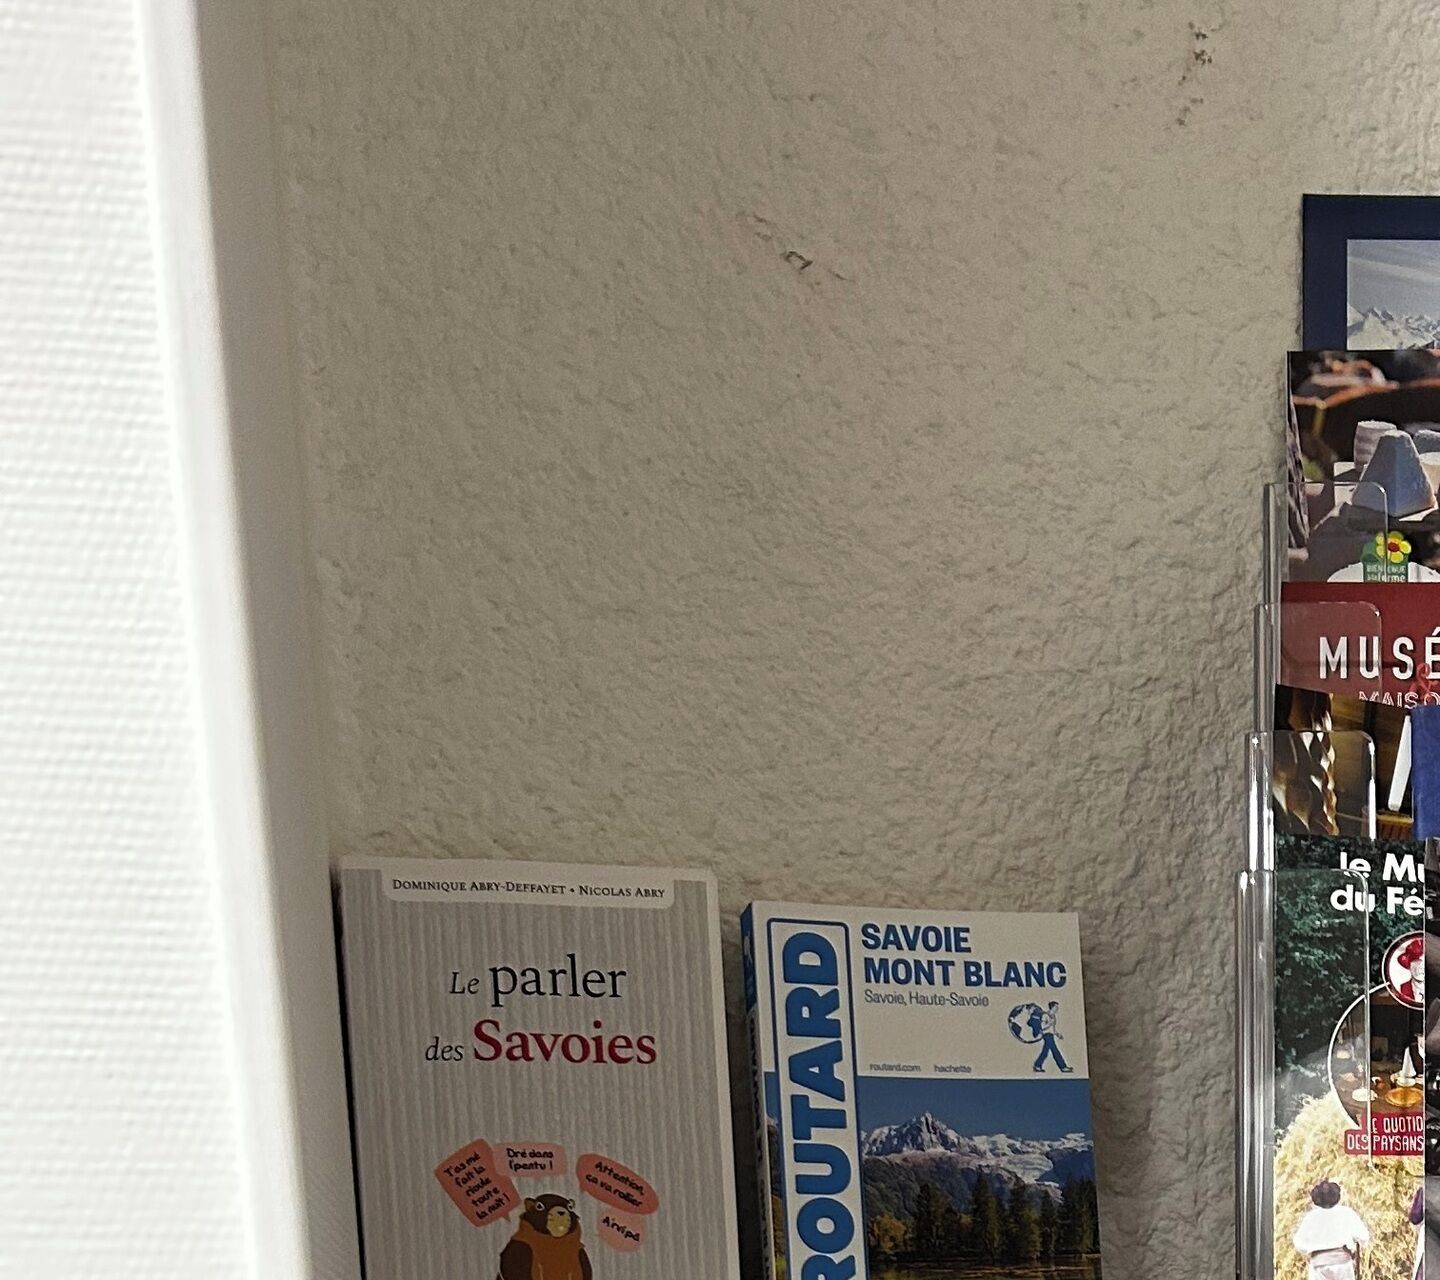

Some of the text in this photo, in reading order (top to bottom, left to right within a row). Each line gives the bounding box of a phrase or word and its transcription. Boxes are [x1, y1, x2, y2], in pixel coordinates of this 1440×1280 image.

[1340, 852, 1371, 878] le
[392, 878, 665, 899] DOMINIQUE ABRY-DEFFAYET NICOLAS ABRY
[1330, 884, 1375, 912] du
[861, 923, 972, 953] SAVOIE
[449, 953, 627, 1008] Le parler
[864, 957, 1067, 988] MONT BLANC
[864, 989, 989, 1008] Savoie, Haute-Savoie
[425, 1018, 657, 1065] des Savoies
[1373, 1134, 1424, 1151] PAYSANS
